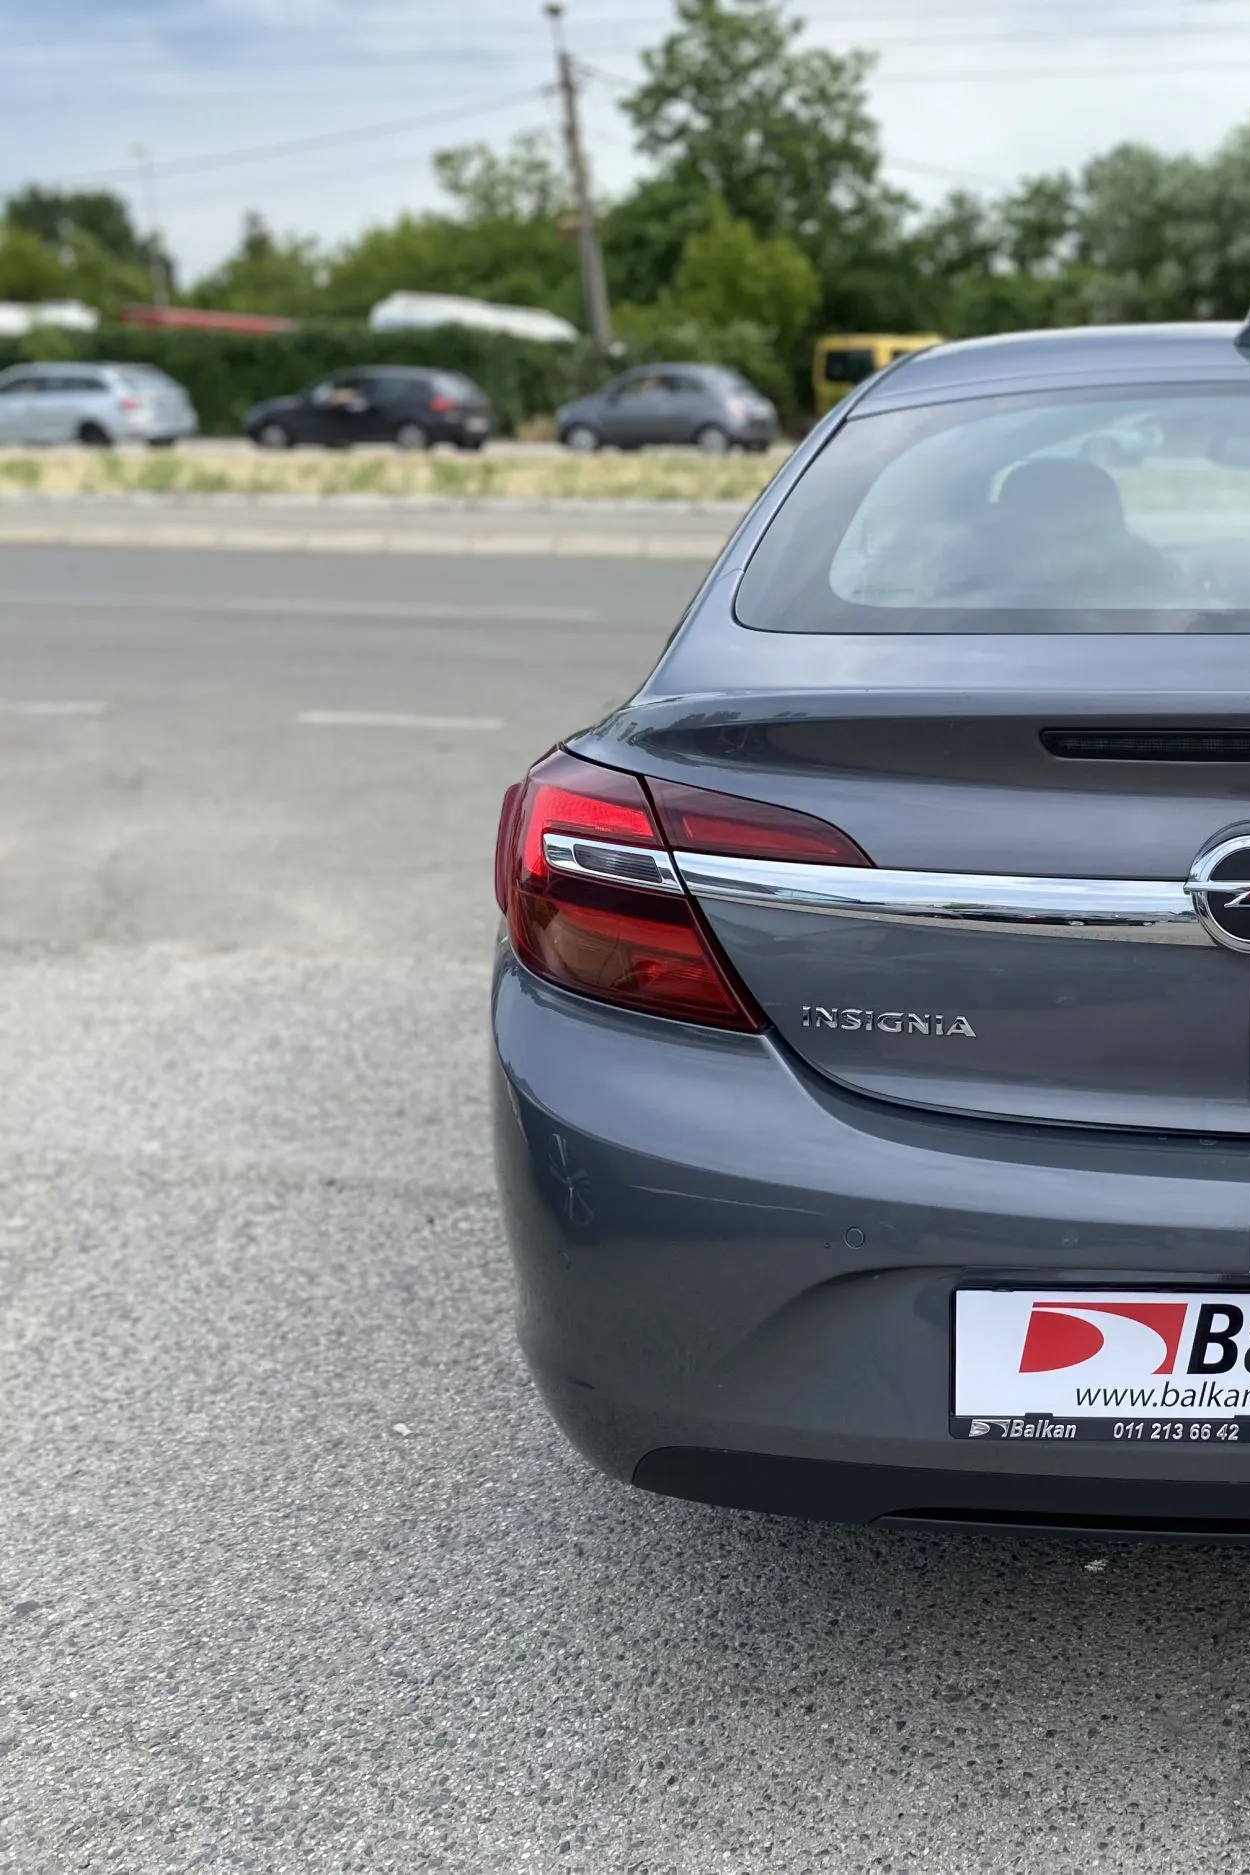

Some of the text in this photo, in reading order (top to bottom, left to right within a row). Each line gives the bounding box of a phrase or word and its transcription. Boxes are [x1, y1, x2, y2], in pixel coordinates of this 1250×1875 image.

[802, 1005, 977, 1038] INSIGNIA
[1010, 1419, 1077, 1439] Balkan
[1113, 1422, 1239, 1441] 011 213 66 42
